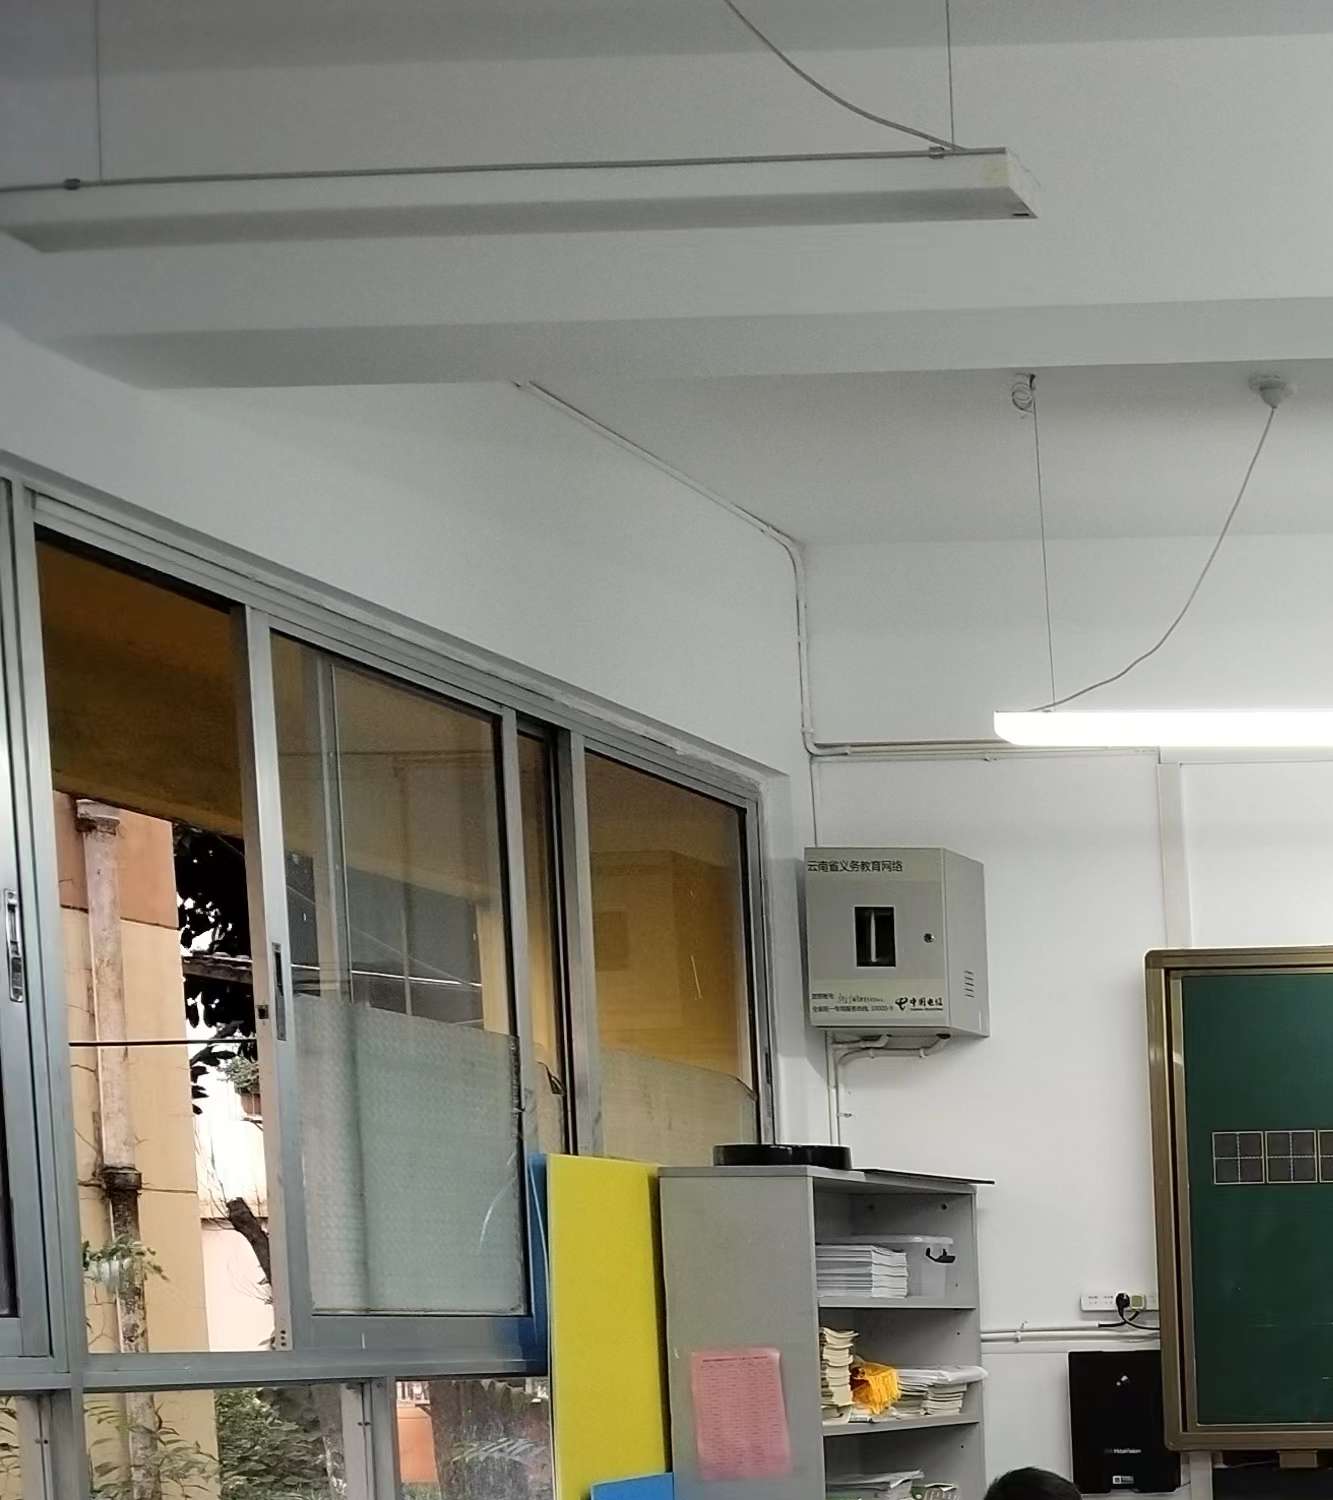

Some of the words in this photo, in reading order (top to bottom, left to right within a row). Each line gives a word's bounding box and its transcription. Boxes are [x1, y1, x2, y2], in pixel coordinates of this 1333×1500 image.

[808, 859, 903, 873] 云南省义务教育网络
[909, 996, 944, 1007] 中国电信
